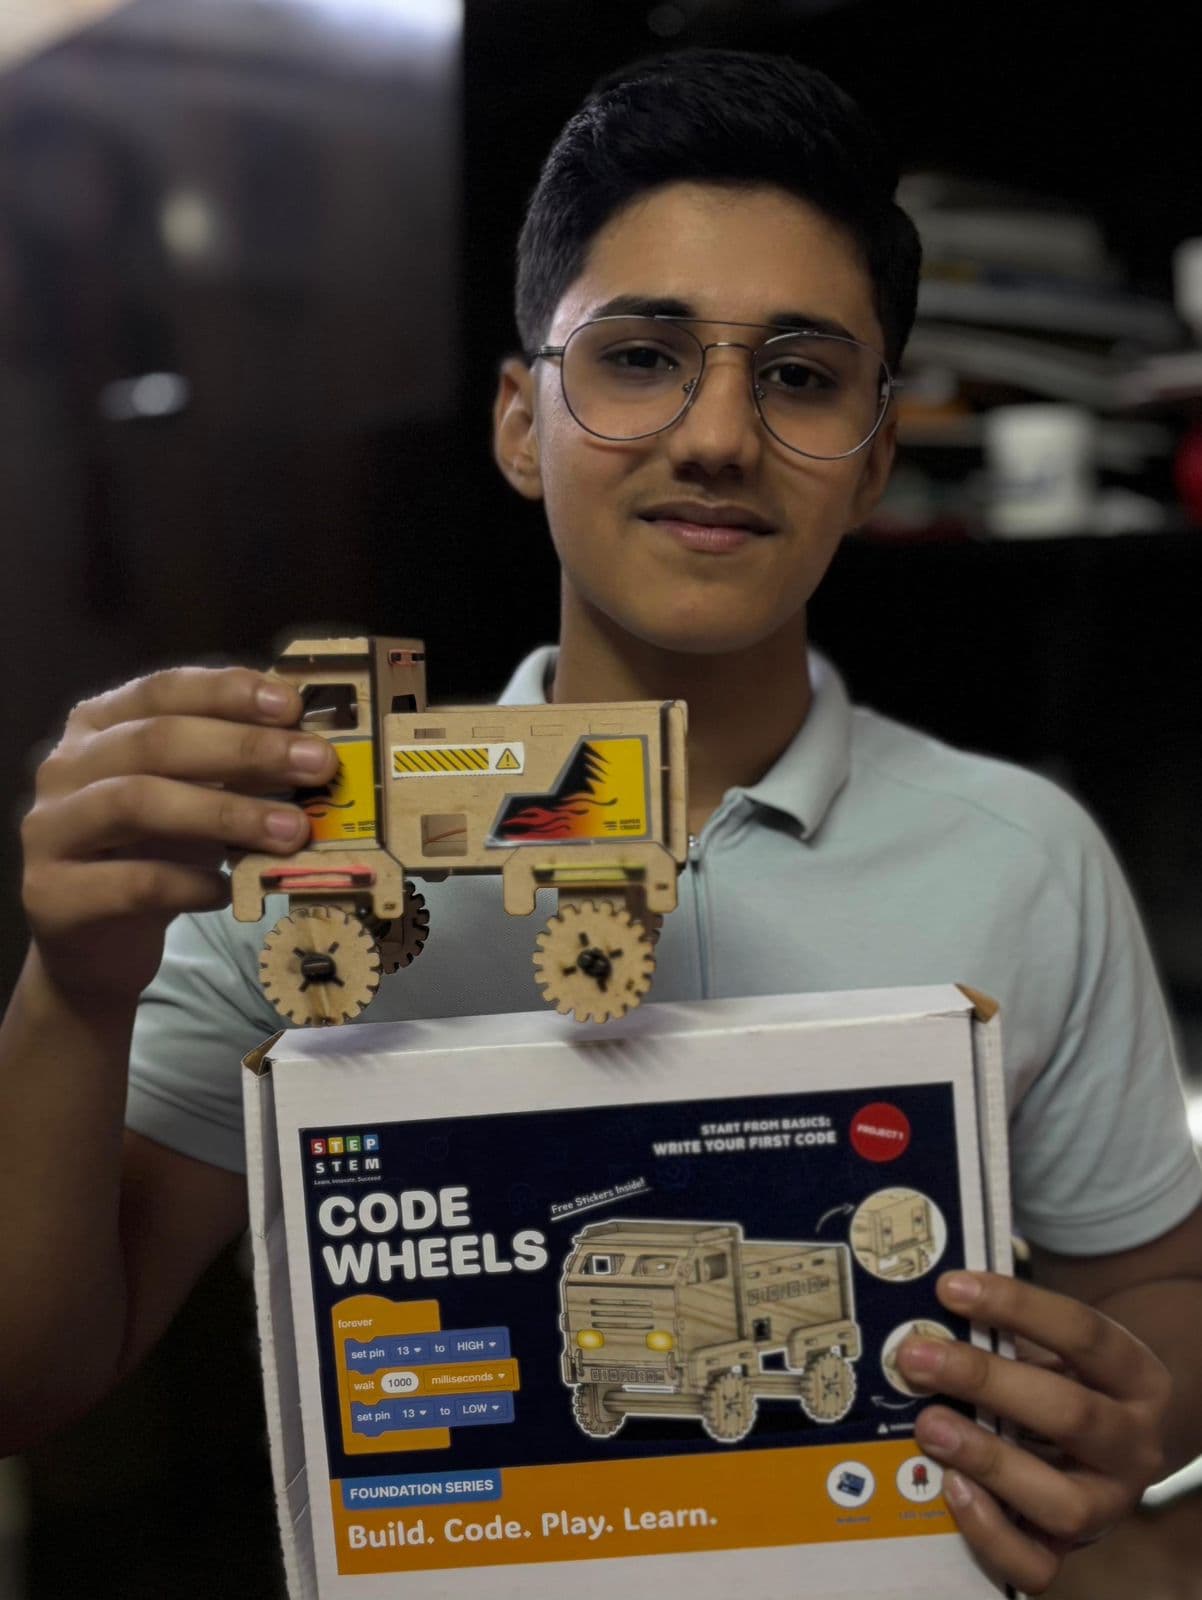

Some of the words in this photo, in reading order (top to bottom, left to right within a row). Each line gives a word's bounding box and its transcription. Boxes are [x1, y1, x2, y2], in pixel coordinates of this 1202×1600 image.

[701, 1121, 741, 1136] START
[743, 1119, 780, 1133] FROM
[781, 1116, 832, 1131] BASICS:
[313, 1137, 377, 1154] STEP
[653, 1140, 702, 1157] WRITE
[704, 1137, 746, 1153] YOUR
[749, 1134, 791, 1149] FIRST
[794, 1130, 838, 1146] CODE
[315, 1157, 380, 1174] STEM
[551, 1202, 574, 1214] Free
[575, 1189, 615, 1207] Stickers
[615, 1176, 646, 1194] Inside!
[318, 1186, 471, 1237] CODE
[322, 1229, 548, 1285] WHEELS
[338, 1317, 373, 1329] forever
[351, 1349, 367, 1359] set
[369, 1348, 385, 1361] pin
[397, 1346, 410, 1356] 13
[434, 1344, 446, 1353] to
[457, 1340, 484, 1351] HIGH
[354, 1380, 375, 1391] wait
[388, 1377, 412, 1388] 1000
[431, 1372, 494, 1385] milliseconds
[357, 1412, 373, 1422] set
[375, 1411, 391, 1424] pin
[402, 1409, 415, 1418] 13
[440, 1407, 451, 1416] to
[462, 1404, 488, 1415] LOW
[349, 1483, 443, 1501] FOUNDATION
[445, 1478, 494, 1494] SERIES
[347, 1519, 435, 1549] Build.
[444, 1514, 532, 1544] Code.
[541, 1510, 614, 1541] Play.
[624, 1506, 719, 1532] Learn.
